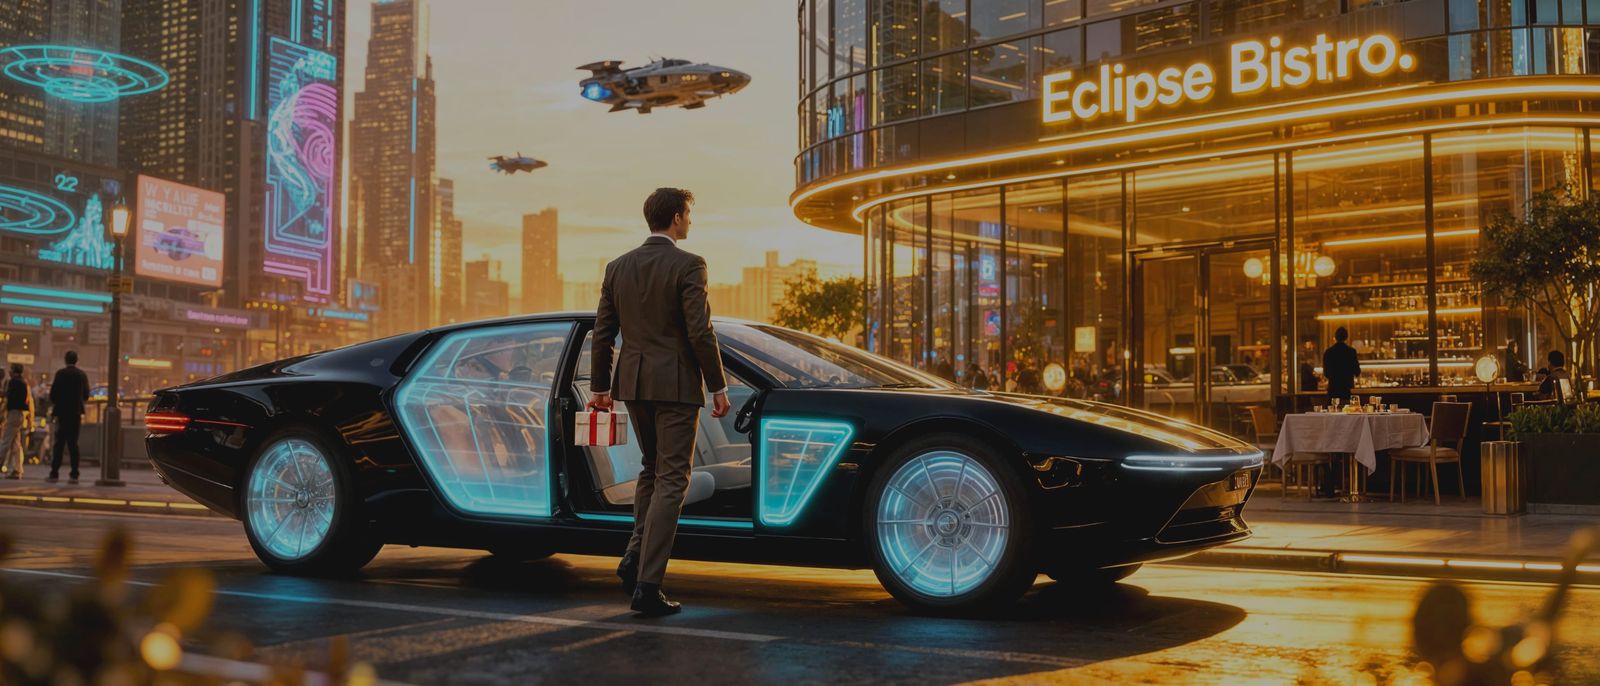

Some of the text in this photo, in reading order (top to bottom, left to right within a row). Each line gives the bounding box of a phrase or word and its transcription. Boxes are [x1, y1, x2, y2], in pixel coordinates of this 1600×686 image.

[1042, 33, 1413, 123] Eclipse Bistro.
[54, 173, 79, 193] 22
